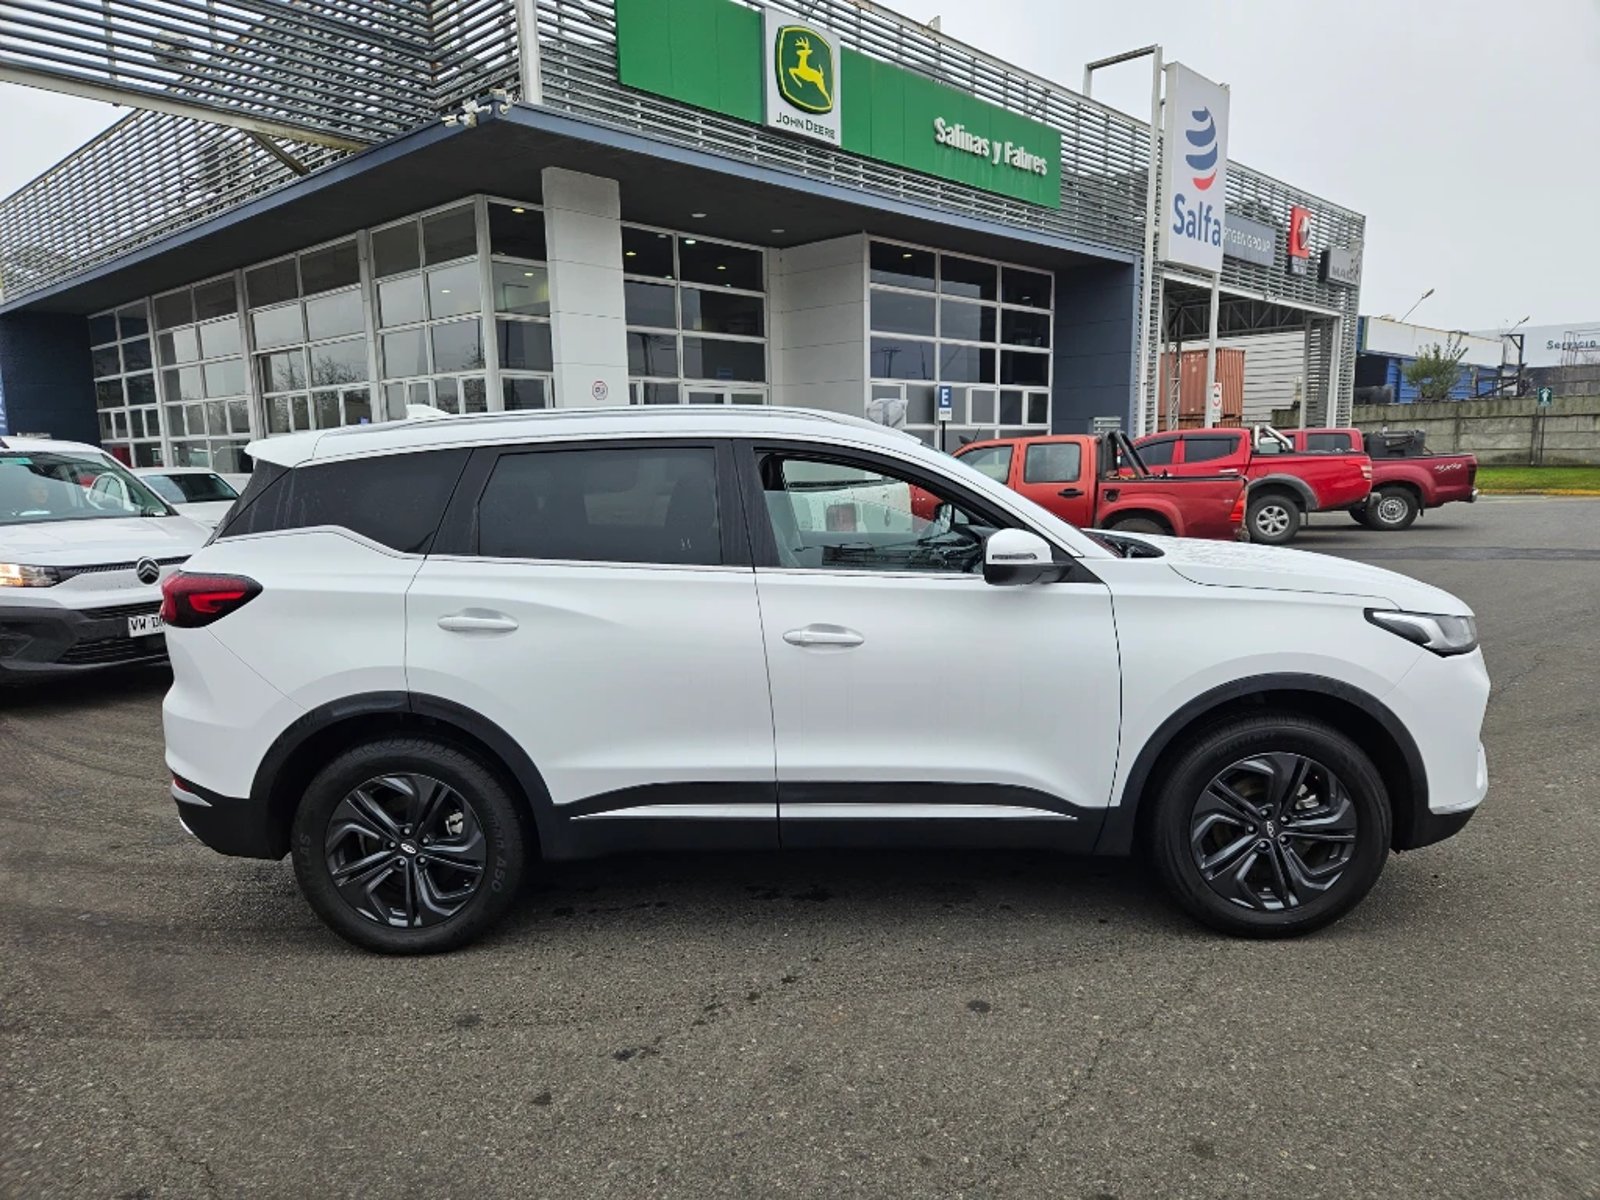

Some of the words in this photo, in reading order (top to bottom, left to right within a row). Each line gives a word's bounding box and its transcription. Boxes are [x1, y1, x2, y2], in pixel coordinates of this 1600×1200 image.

[776, 112, 804, 129] JOHN
[805, 119, 835, 140] DEERE
[934, 116, 990, 157] Salinas
[992, 141, 1002, 165] y
[1004, 141, 1048, 176] Fabres
[1173, 193, 1221, 247] Salfa
[941, 388, 950, 405] E
[130, 618, 146, 631] VW
